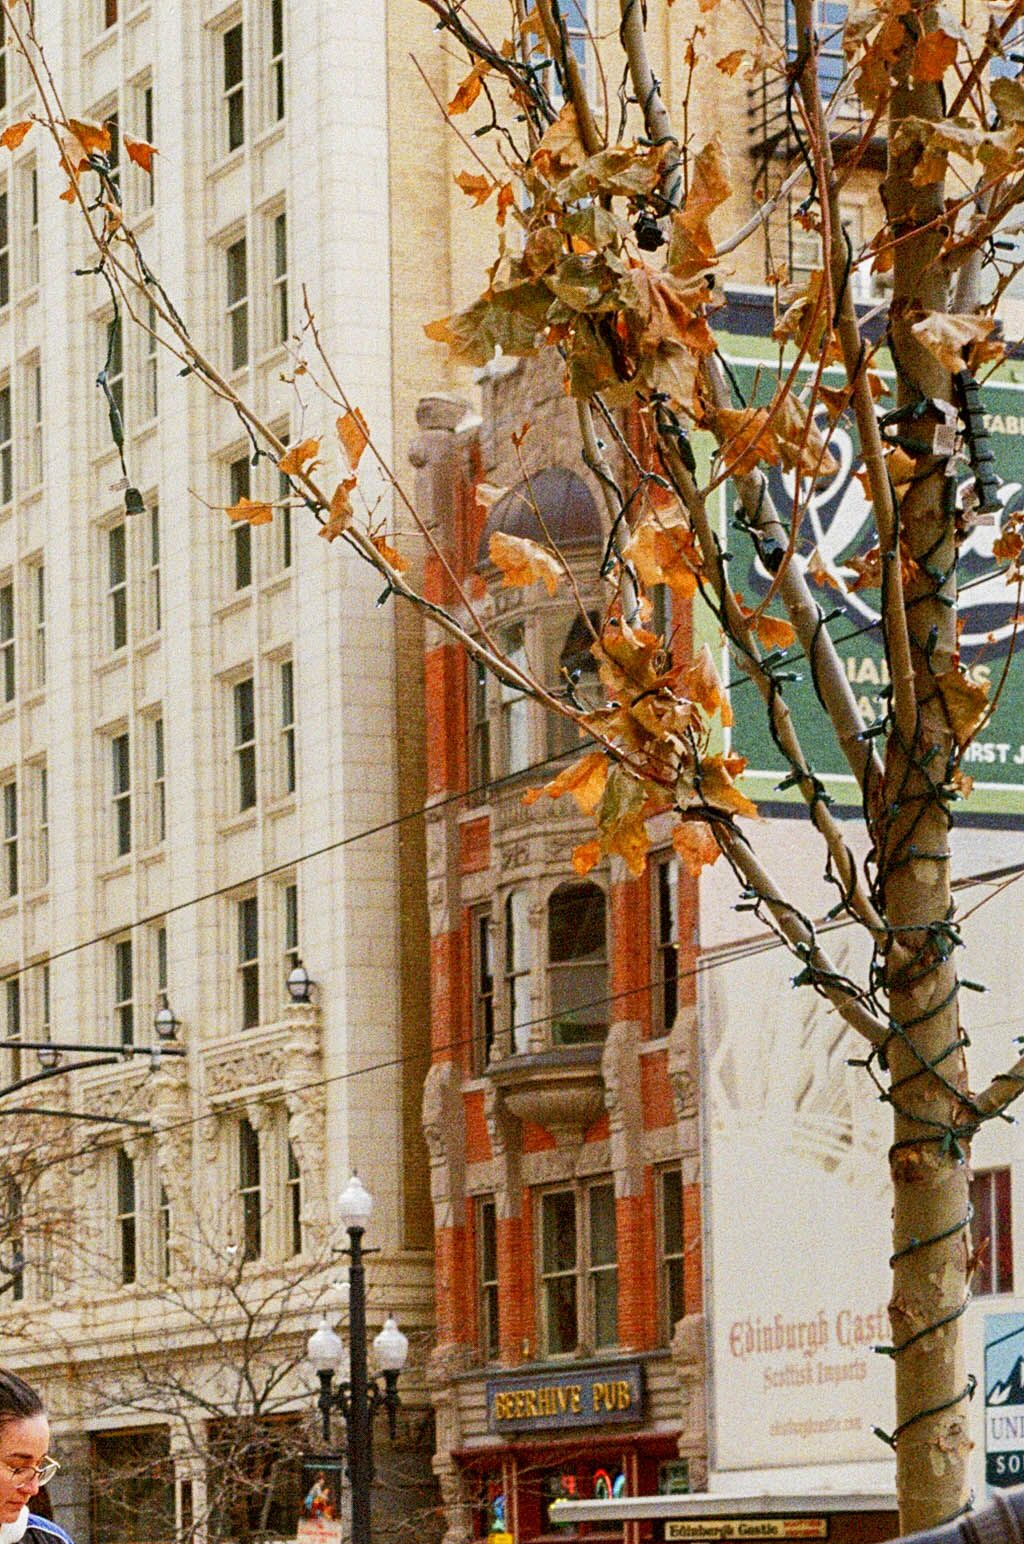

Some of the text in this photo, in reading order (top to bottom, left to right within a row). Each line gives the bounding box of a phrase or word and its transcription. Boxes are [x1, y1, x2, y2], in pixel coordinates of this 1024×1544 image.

[730, 1310, 828, 1360] Edinburgh
[495, 1380, 631, 1420] BEERHIVE PUB
[738, 1523, 778, 1536] Castle
